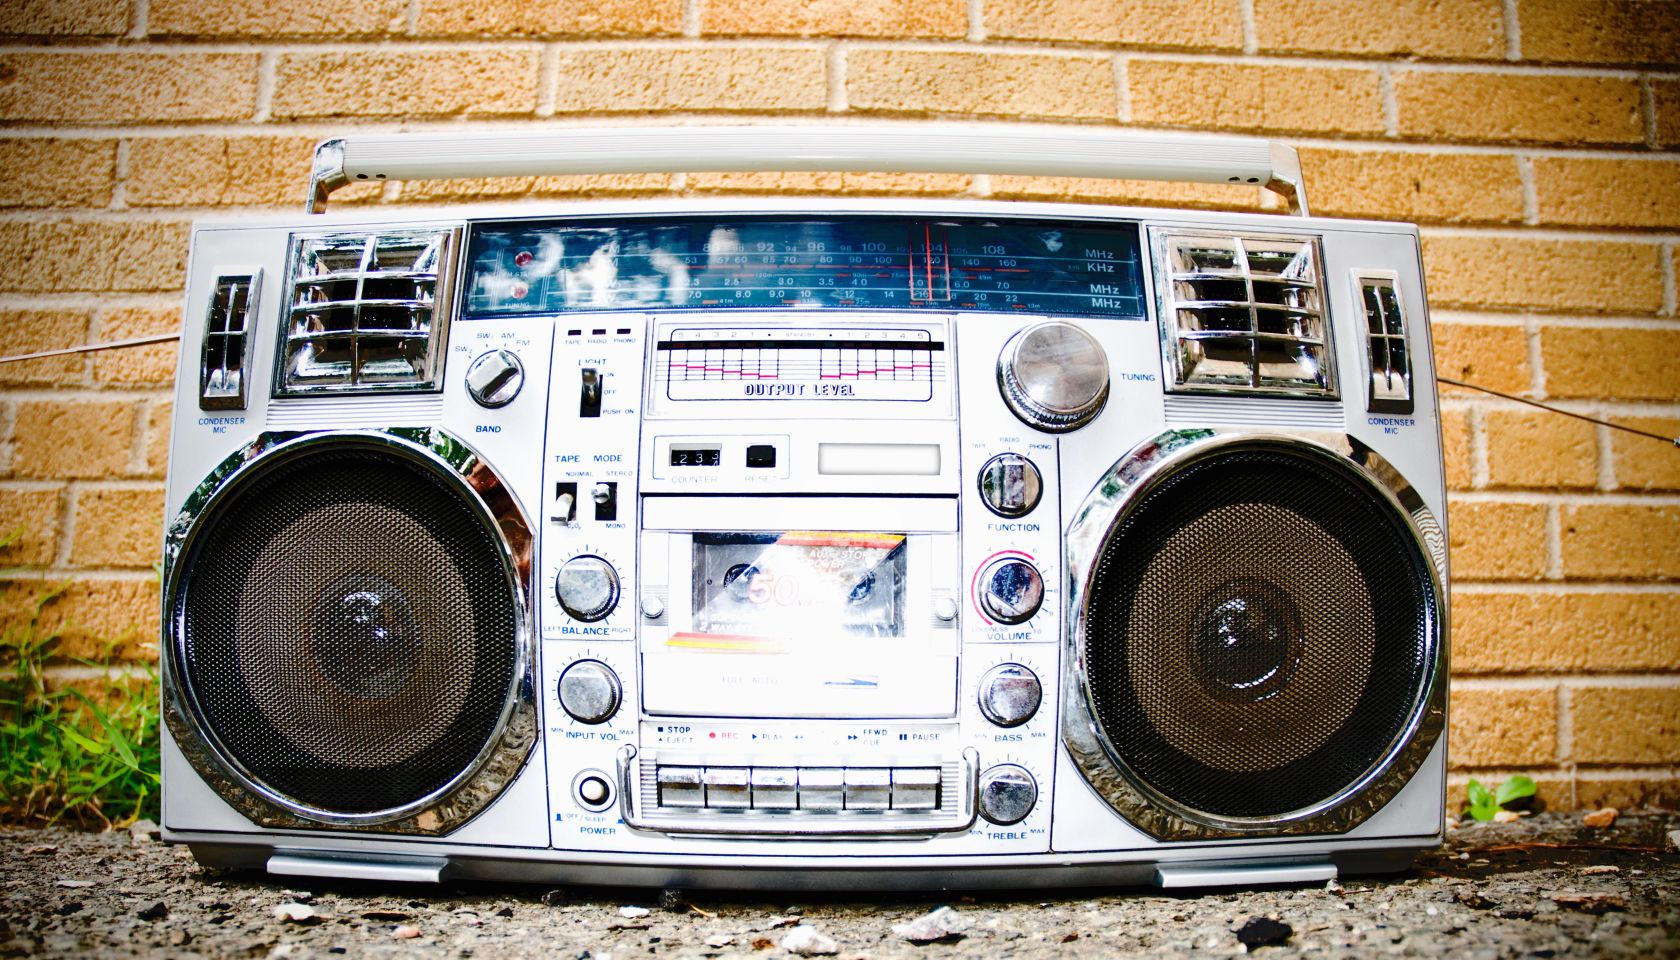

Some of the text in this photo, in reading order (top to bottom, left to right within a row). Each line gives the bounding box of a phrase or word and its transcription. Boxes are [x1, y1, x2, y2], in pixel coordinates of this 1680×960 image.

[756, 242, 774, 252] 92
[807, 242, 825, 252] 96
[862, 242, 887, 252] 100
[920, 243, 944, 252] 104
[982, 245, 1006, 255] 108
[1085, 248, 1115, 260] MHz
[734, 256, 748, 264] 60
[762, 256, 776, 264] 65
[784, 256, 798, 264] 70
[819, 256, 834, 264] 80
[874, 256, 893, 264] 100
[962, 258, 980, 266] 140
[1087, 262, 1115, 273] KHz
[778, 278, 794, 286] 3.0
[818, 279, 834, 287] 3.5
[851, 279, 868, 287] 4.0
[954, 281, 970, 289] 6.0
[1089, 284, 1120, 295] MHz
[735, 291, 751, 299] 8.0
[769, 291, 785, 299] 9.0
[844, 290, 855, 298] 12
[884, 290, 895, 299] 14
[973, 293, 987, 301] 20
[1005, 294, 1018, 302] 22
[1091, 298, 1122, 309] MHz
[1121, 373, 1156, 381] TUNING
[744, 384, 856, 396] OUTPUT LEVEL
[198, 417, 246, 425] CONDENSER
[1367, 417, 1416, 426] CONDENSER
[213, 426, 227, 434] MIC
[475, 426, 502, 434] BAND
[1384, 427, 1398, 435] MIC
[555, 454, 623, 463] TAPE MODE
[606, 470, 634, 478] STEREO
[671, 475, 718, 484] COUNTER
[988, 523, 1041, 532] FUNCTION
[749, 574, 800, 607] 50
[562, 626, 610, 636] BALANCE
[987, 632, 1032, 641] VOLUME
[566, 731, 621, 741] INPUT VOL
[912, 733, 941, 741] PAUSE
[994, 734, 1023, 742] BASS
[580, 827, 616, 835] POWER
[987, 832, 1028, 840] TREBLE
